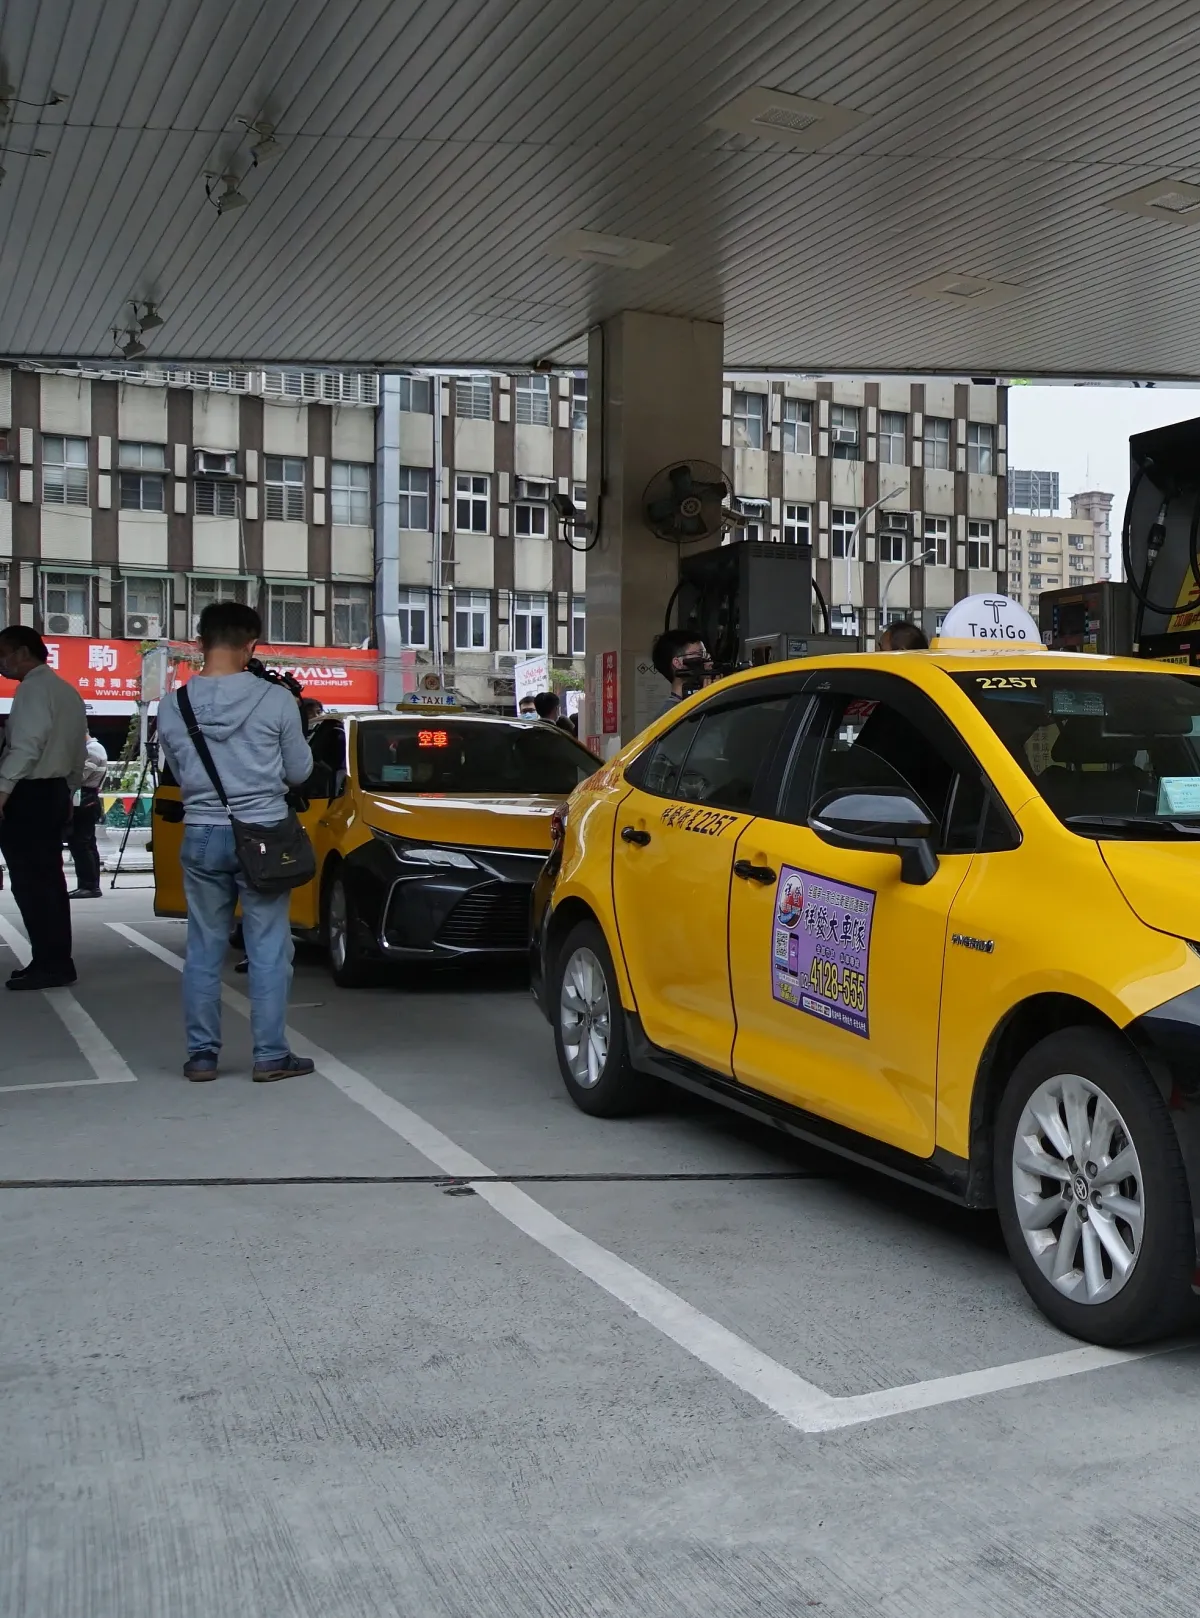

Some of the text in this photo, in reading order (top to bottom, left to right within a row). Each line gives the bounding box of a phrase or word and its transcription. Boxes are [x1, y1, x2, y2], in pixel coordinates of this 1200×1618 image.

[968, 624, 1026, 640] TaxiGo
[976, 677, 1038, 689] 2257
[421, 696, 444, 705] TAXI
[418, 730, 448, 748] 空車
